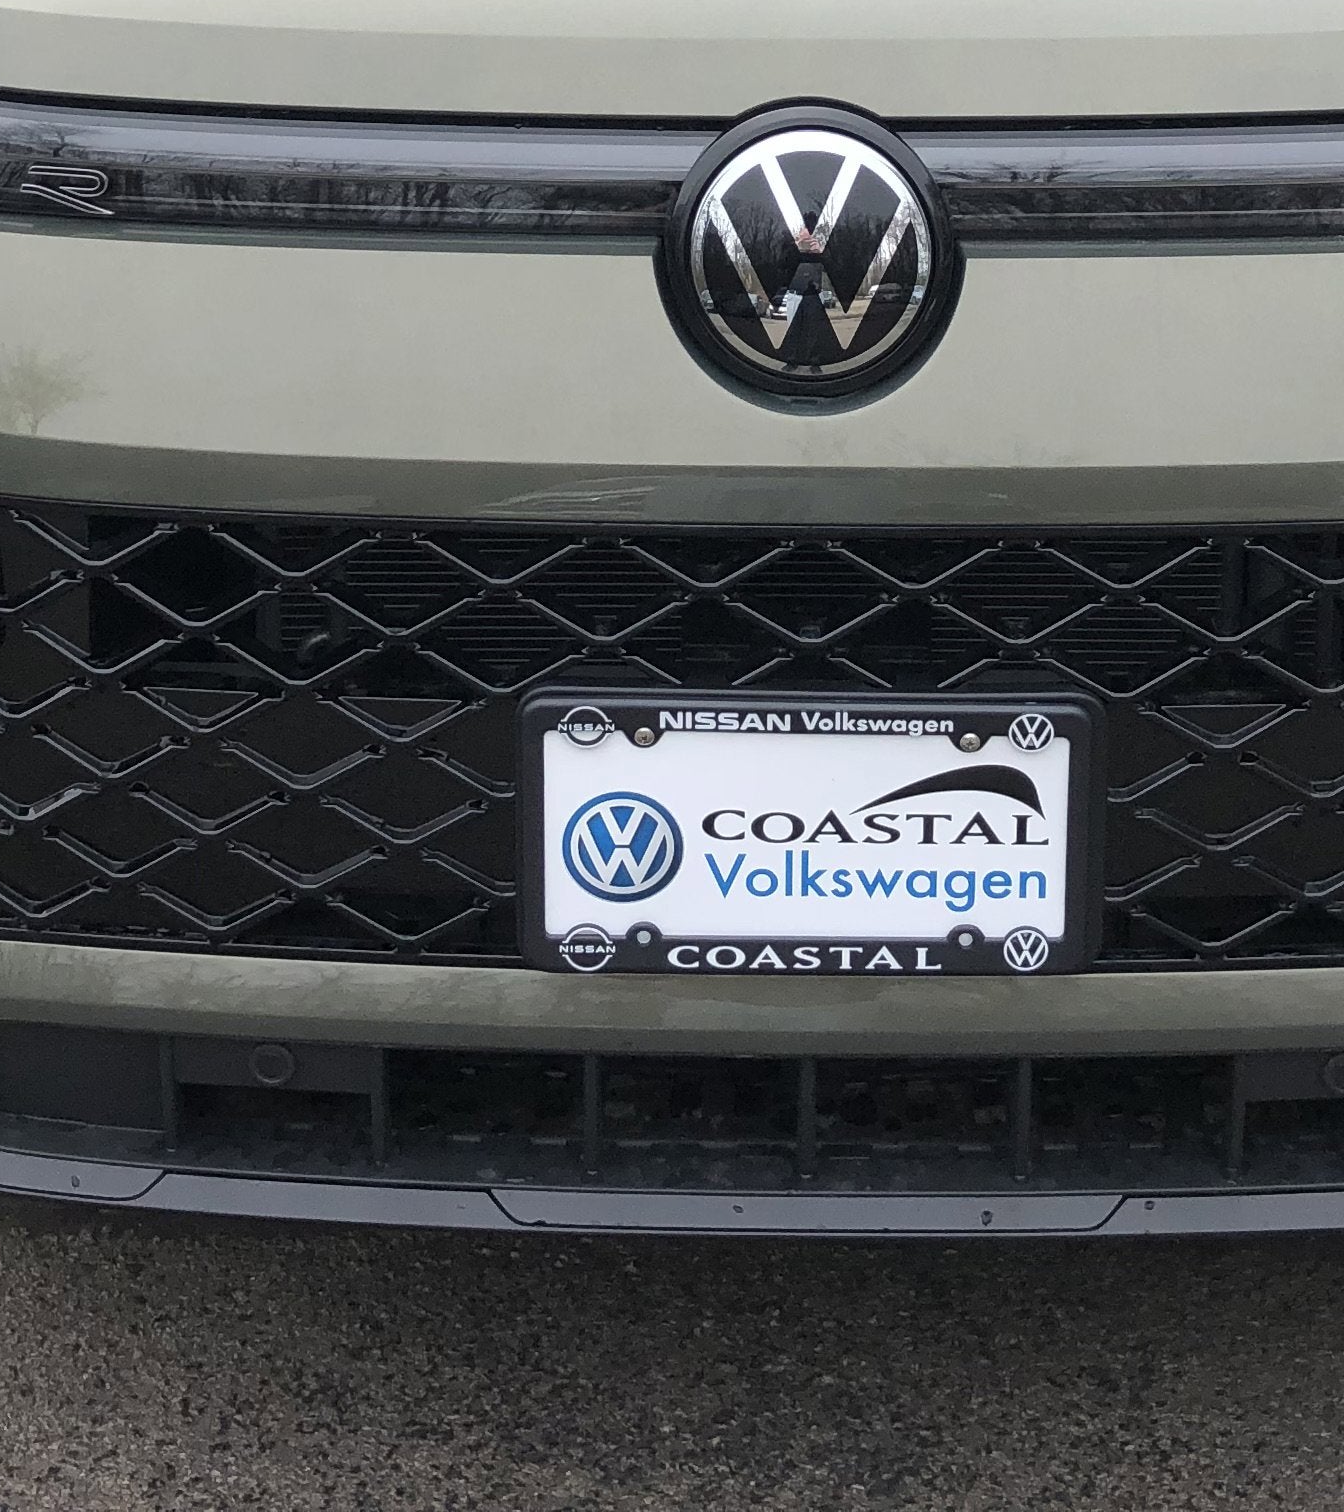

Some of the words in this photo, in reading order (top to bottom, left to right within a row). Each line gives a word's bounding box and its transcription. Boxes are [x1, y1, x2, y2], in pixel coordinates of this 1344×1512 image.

[19, 165, 116, 216] R
[557, 721, 616, 733] NISSAN
[659, 710, 792, 732] NISSAN
[800, 710, 954, 737] Volkswagen
[700, 808, 1050, 846] COASTAL
[703, 849, 1048, 913] Volkswagen
[558, 942, 616, 955] NISSAN
[666, 944, 943, 971] COASTAL
